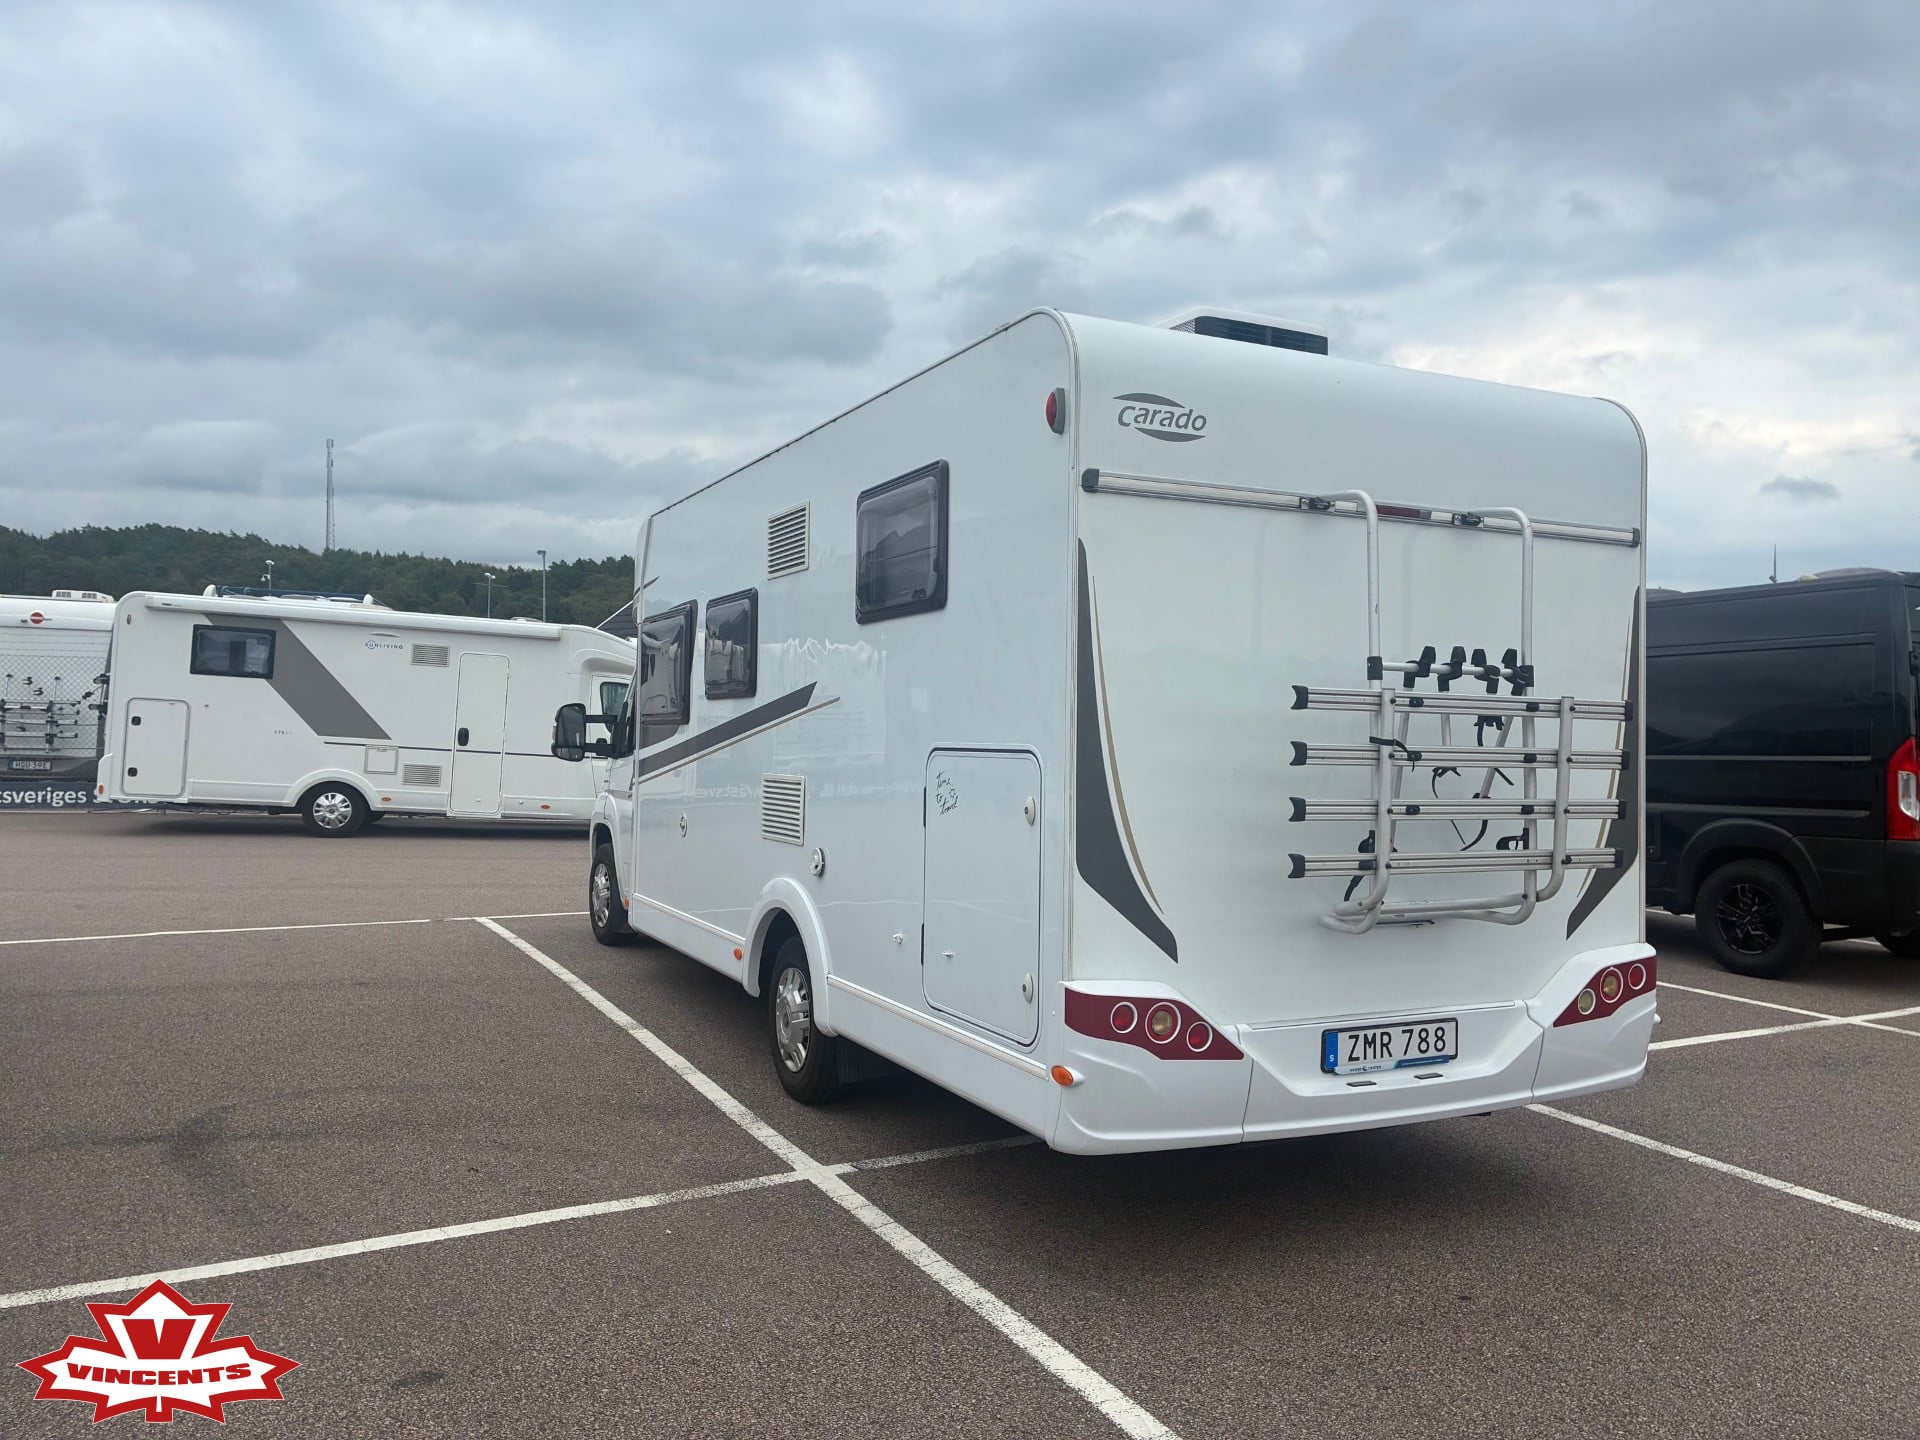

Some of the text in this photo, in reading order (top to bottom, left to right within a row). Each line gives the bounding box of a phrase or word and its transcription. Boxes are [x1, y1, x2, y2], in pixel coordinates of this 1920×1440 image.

[1347, 1026, 1446, 1062] ZMR 788
[1329, 1054, 1335, 1062] S
